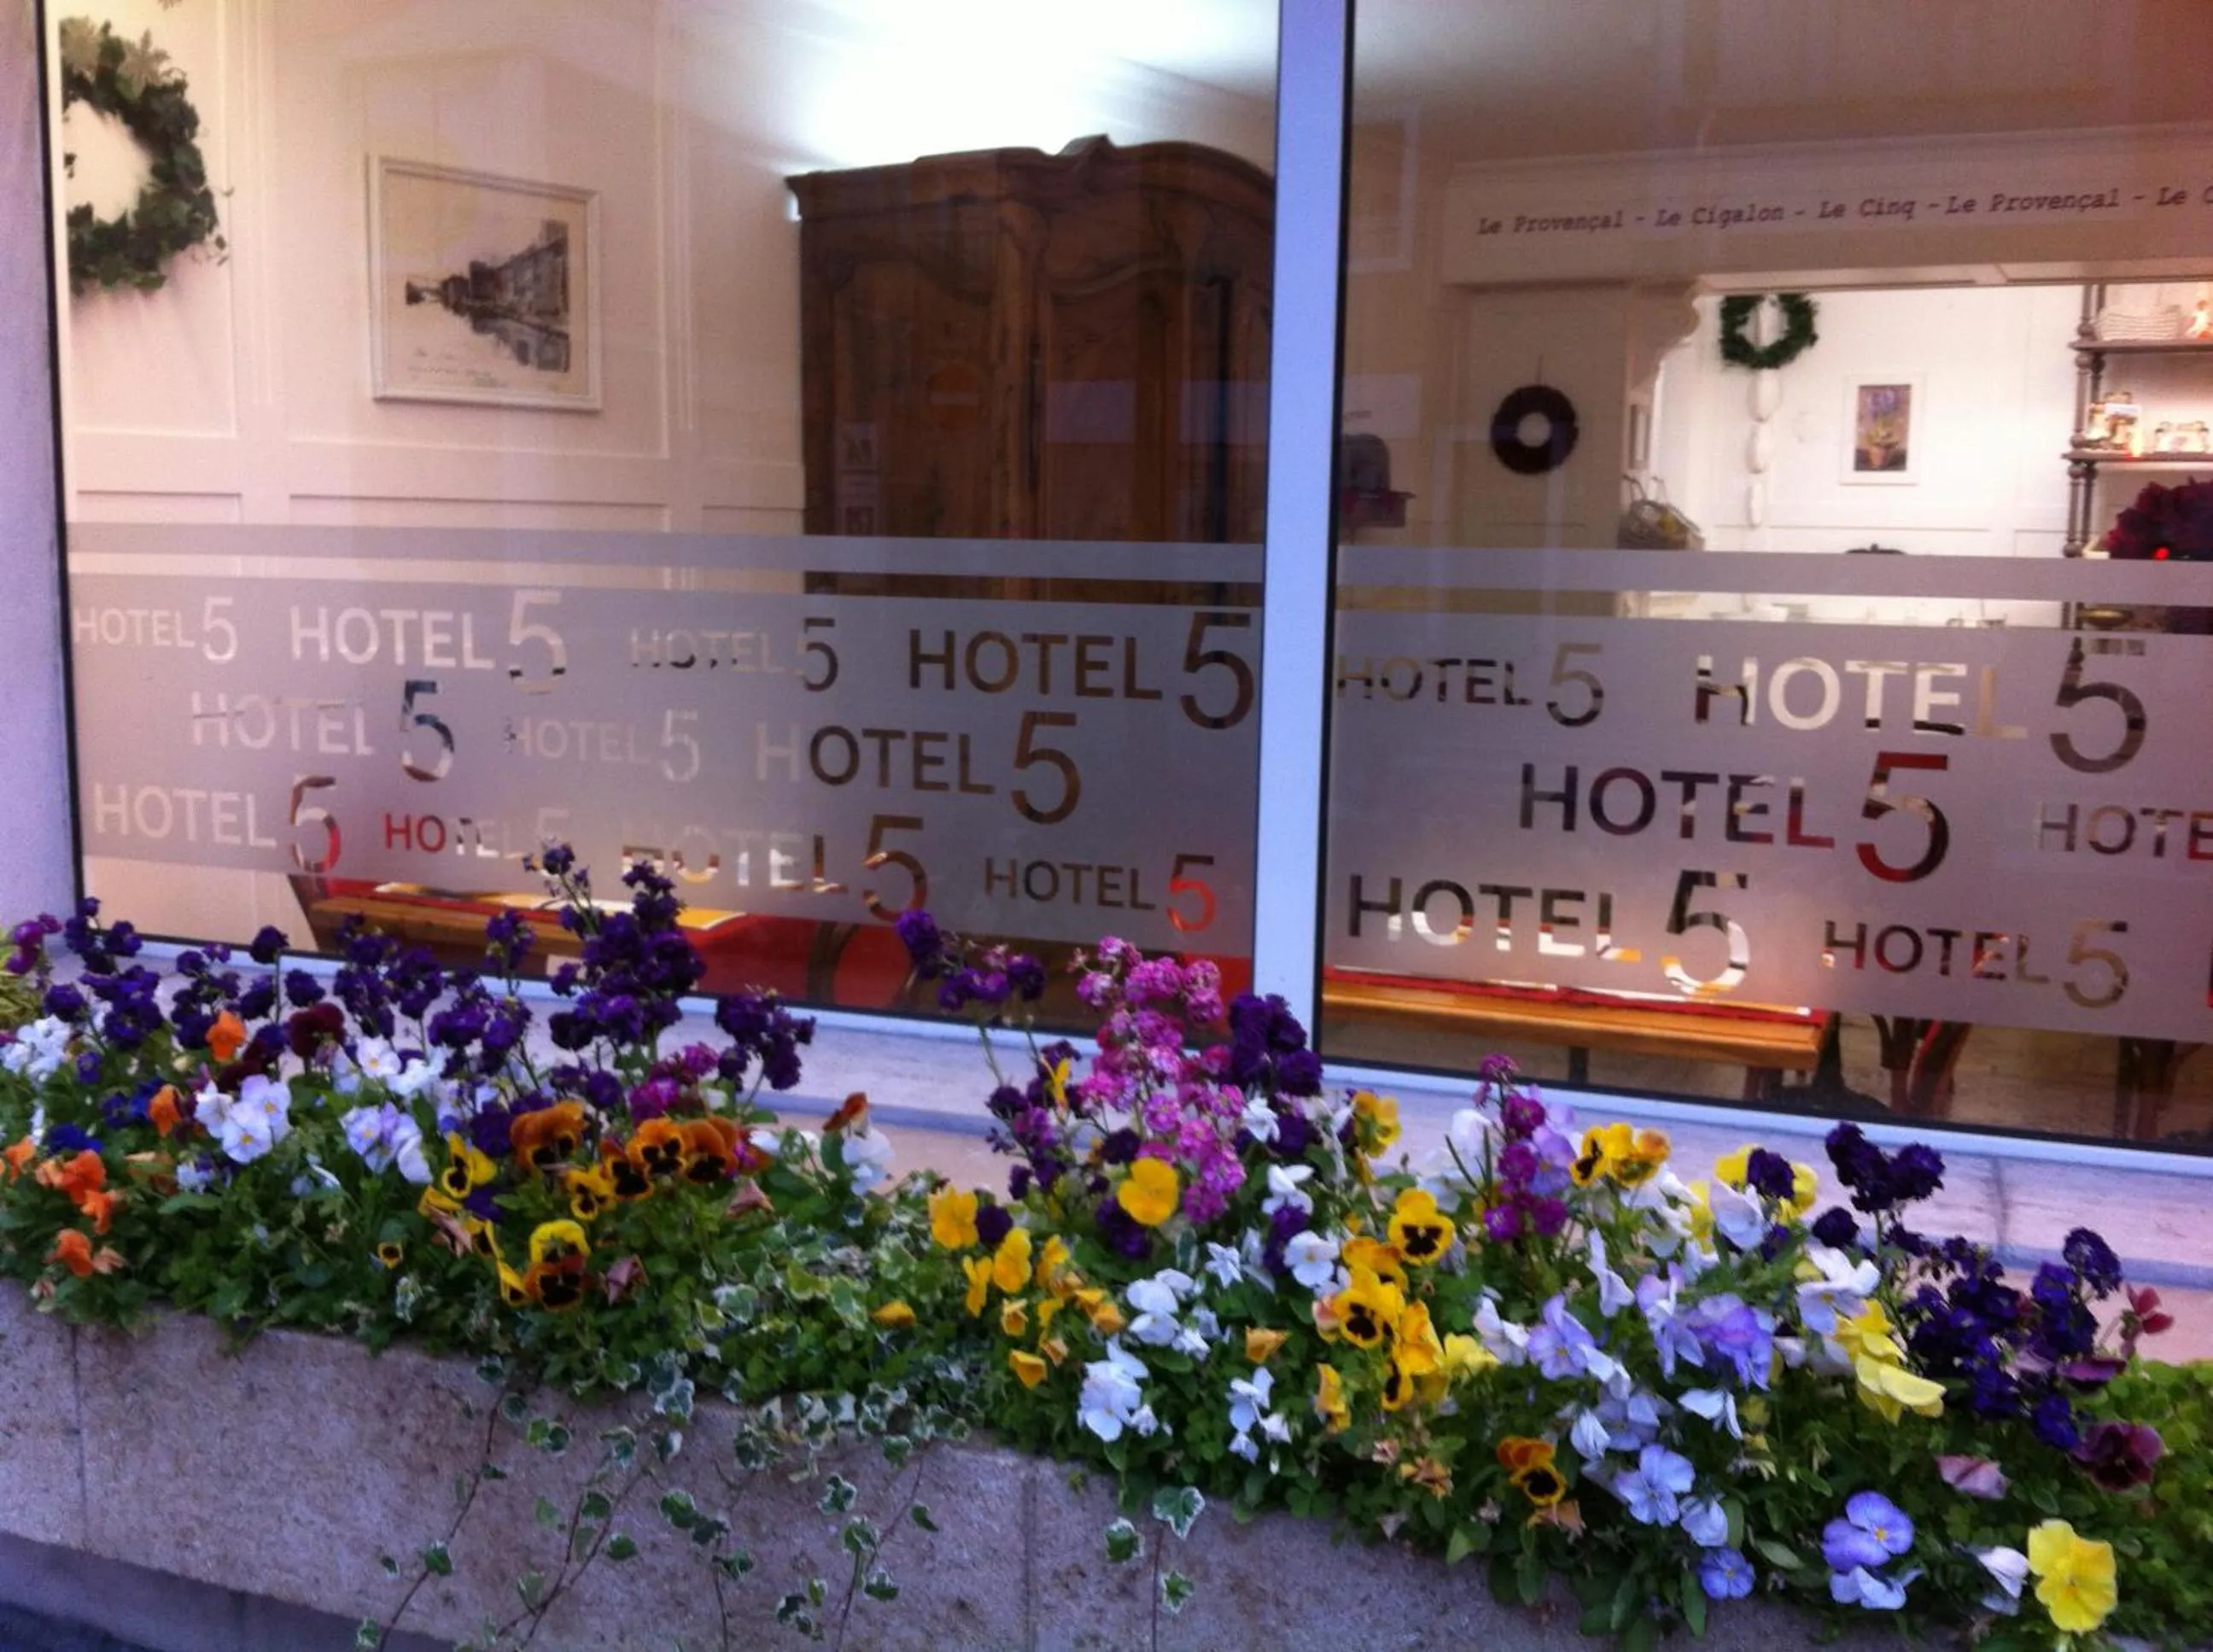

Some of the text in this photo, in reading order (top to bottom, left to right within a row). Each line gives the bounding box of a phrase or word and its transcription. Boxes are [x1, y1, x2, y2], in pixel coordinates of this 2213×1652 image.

[1477, 217, 1503, 235] Le
[1513, 210, 1624, 234] Provençal
[1654, 209, 1682, 227] Le
[1690, 203, 1784, 230] Cigalon
[1818, 200, 1846, 219] Le
[1859, 197, 1917, 221] Cinq
[1945, 196, 1977, 214] Le
[1988, 188, 2119, 213] Provençal
[2156, 186, 2187, 206] Le
[73, 596, 238, 664] HOTEL 5
[289, 589, 568, 694] HOTEL 5
[629, 616, 839, 692] HOTEL 5
[908, 611, 1256, 731] HOTEL 5
[190, 680, 456, 783] HOTEL 5
[1337, 643, 1605, 728] HOTEL 5
[1694, 637, 2147, 773] HOTEL 5
[504, 708, 700, 783] HOTEL 5
[756, 710, 1082, 826] HOTEL 5
[91, 774, 342, 874] HOTEL 5
[383, 812, 523, 860] HOTEL
[1520, 750, 1950, 884] HOTEL 5
[2033, 801, 2213, 861] HOTE
[621, 814, 928, 923] HOTEL 5
[984, 854, 1217, 934] HOTEL 5
[1348, 869, 1751, 998] HOTEL 5
[1820, 919, 2050, 986] HOTEL
[2062, 919, 2130, 1010] 5
